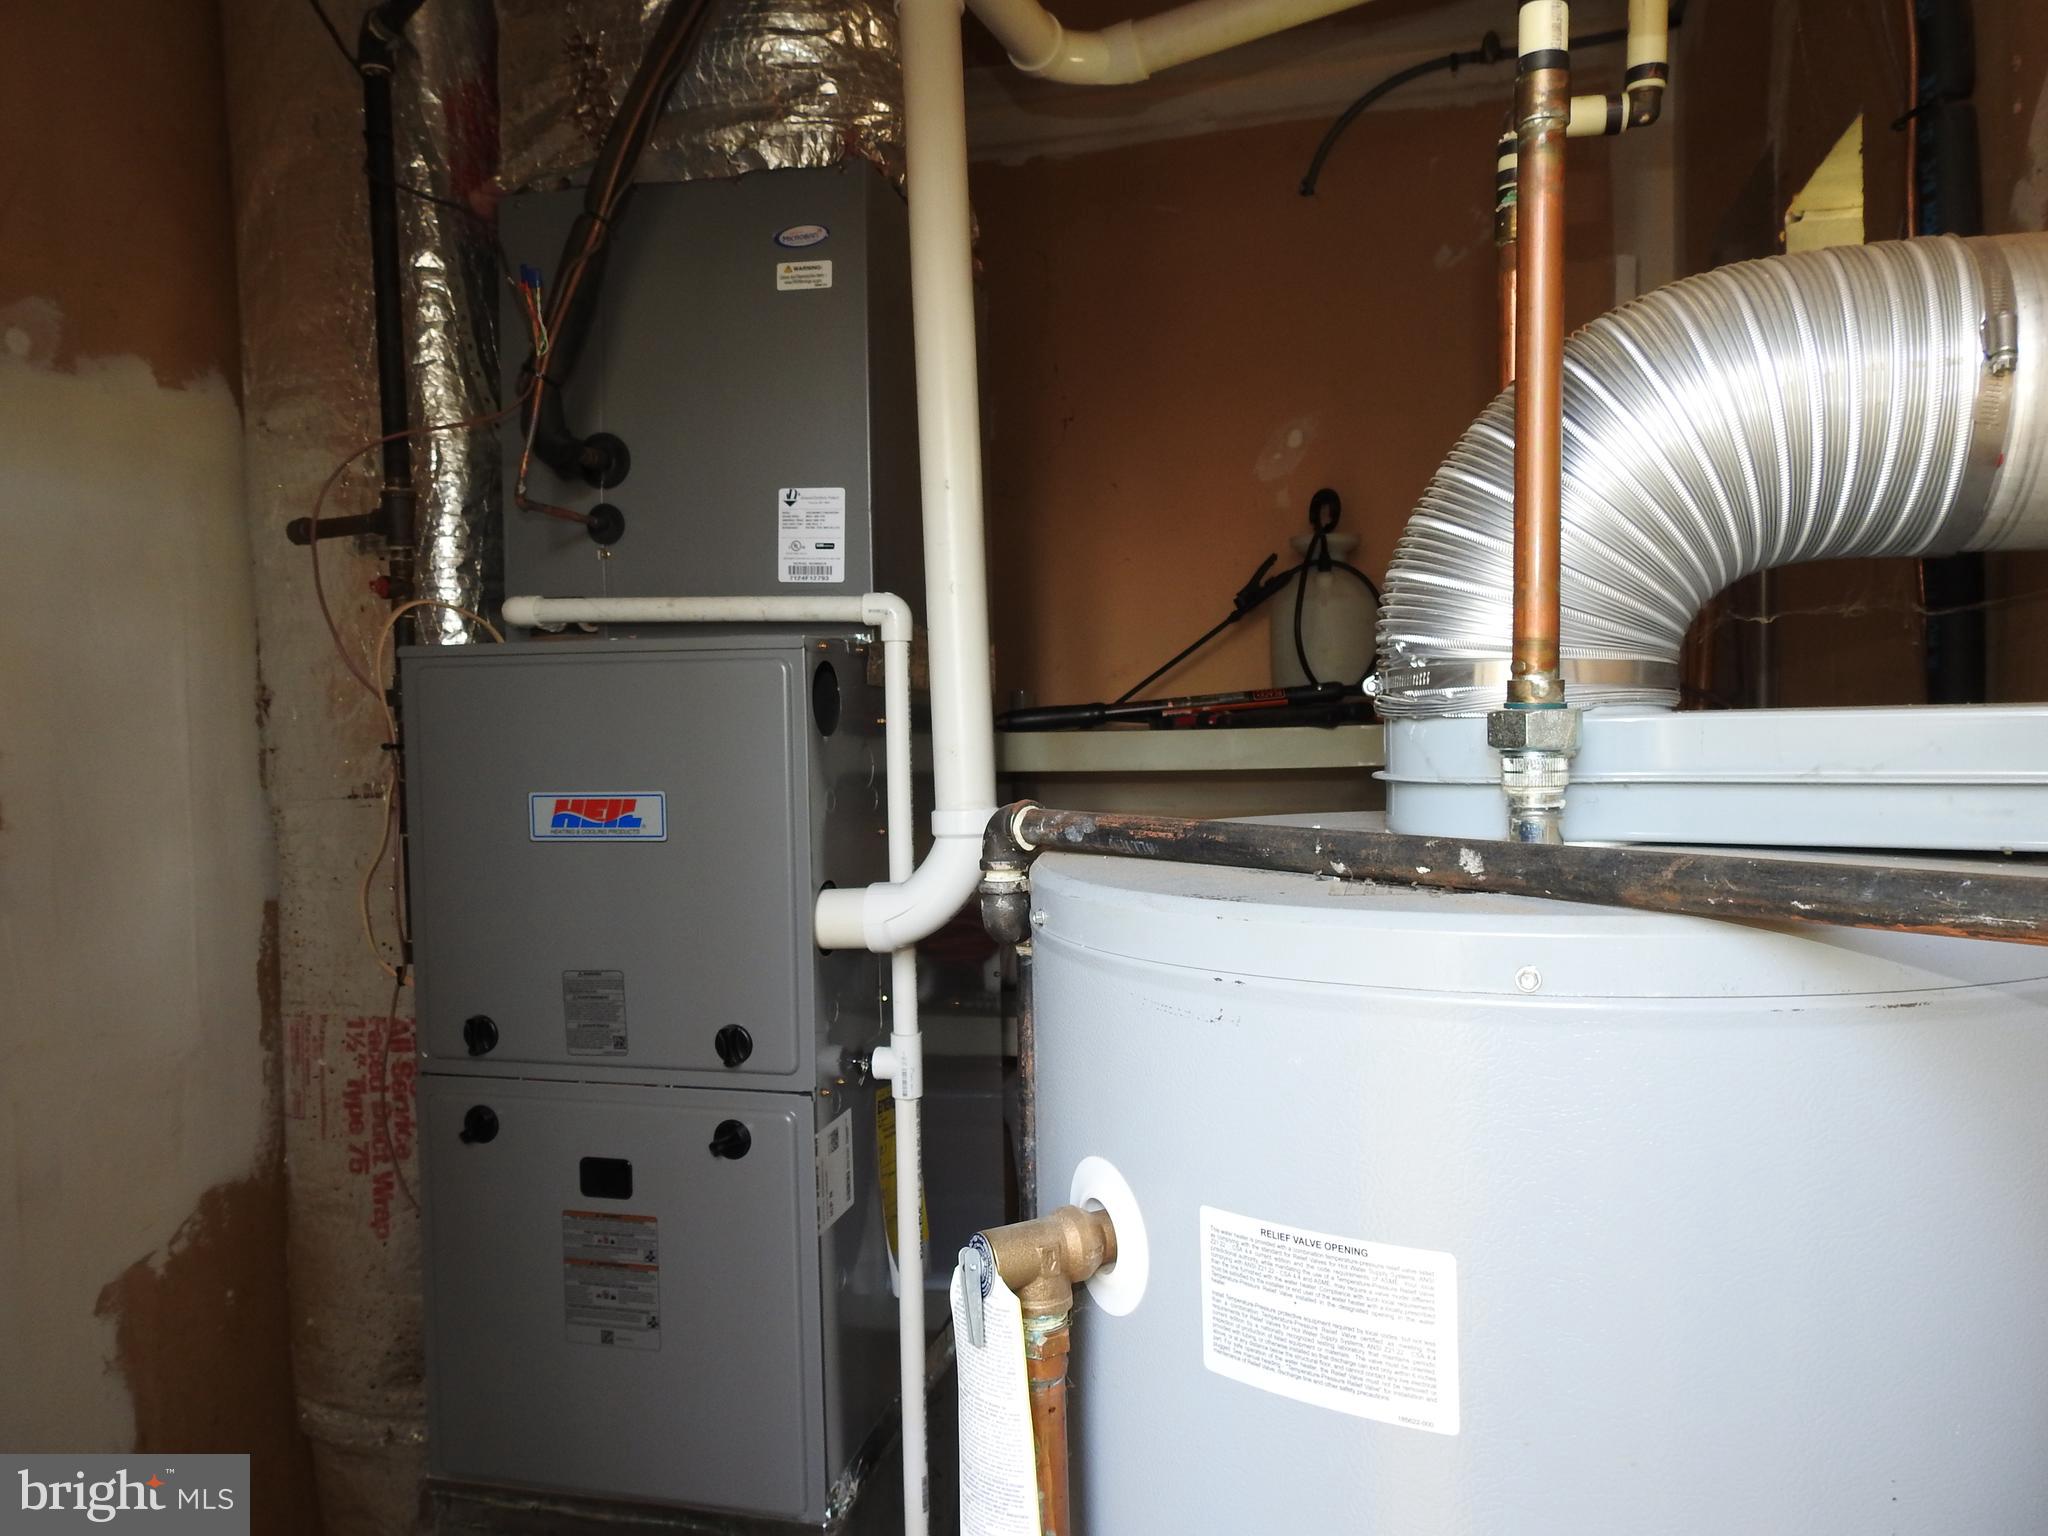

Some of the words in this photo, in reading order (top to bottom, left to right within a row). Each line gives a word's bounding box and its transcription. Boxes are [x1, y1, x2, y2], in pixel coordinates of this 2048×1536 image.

[551, 799, 642, 828] HEIL
[344, 1075, 367, 1136] Type
[392, 1060, 416, 1161] Service
[368, 1171, 395, 1242] Wrap
[1260, 1228, 1291, 1242] RELIEF
[1293, 1234, 1322, 1249] VALVE
[1324, 1241, 1369, 1258] OPENING
